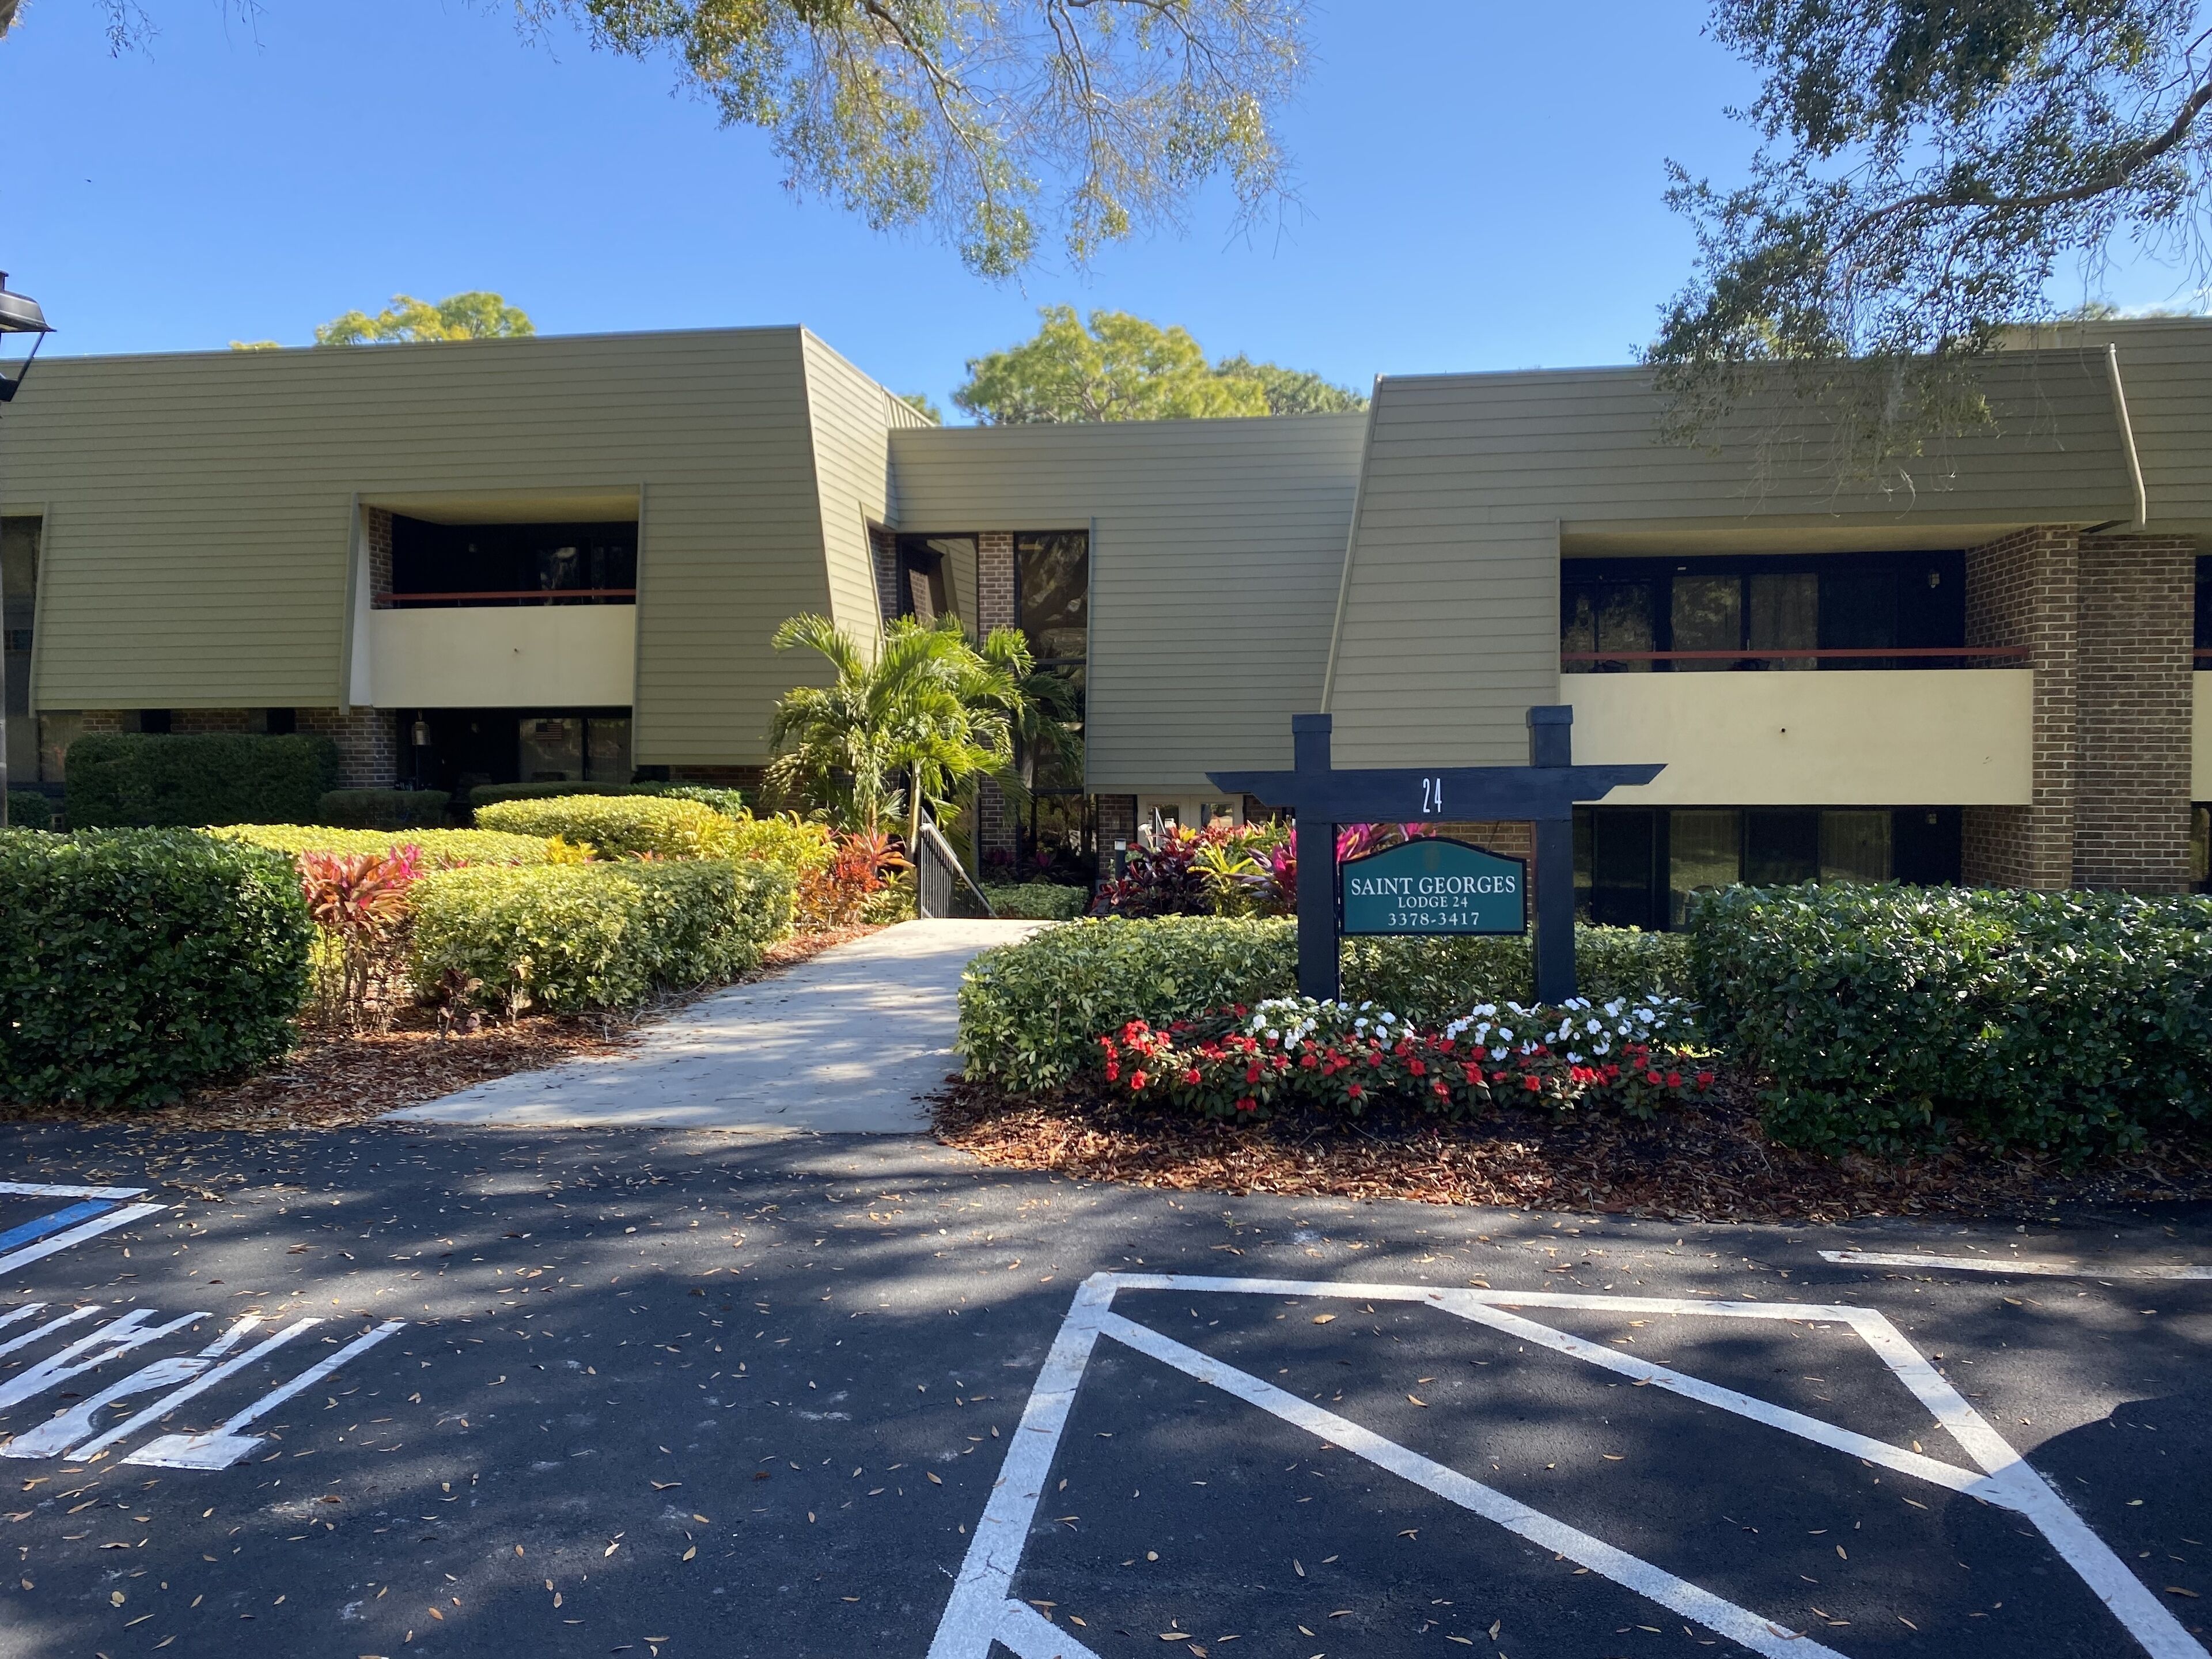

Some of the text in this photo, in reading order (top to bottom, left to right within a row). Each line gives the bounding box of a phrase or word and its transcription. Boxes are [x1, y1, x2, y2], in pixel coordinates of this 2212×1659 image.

[1422, 778, 1442, 813] 24
[1350, 875, 1517, 896] SAINT GEORGES
[1397, 896, 1469, 908] LODGE 24
[1388, 912, 1480, 926] 3378-3417
